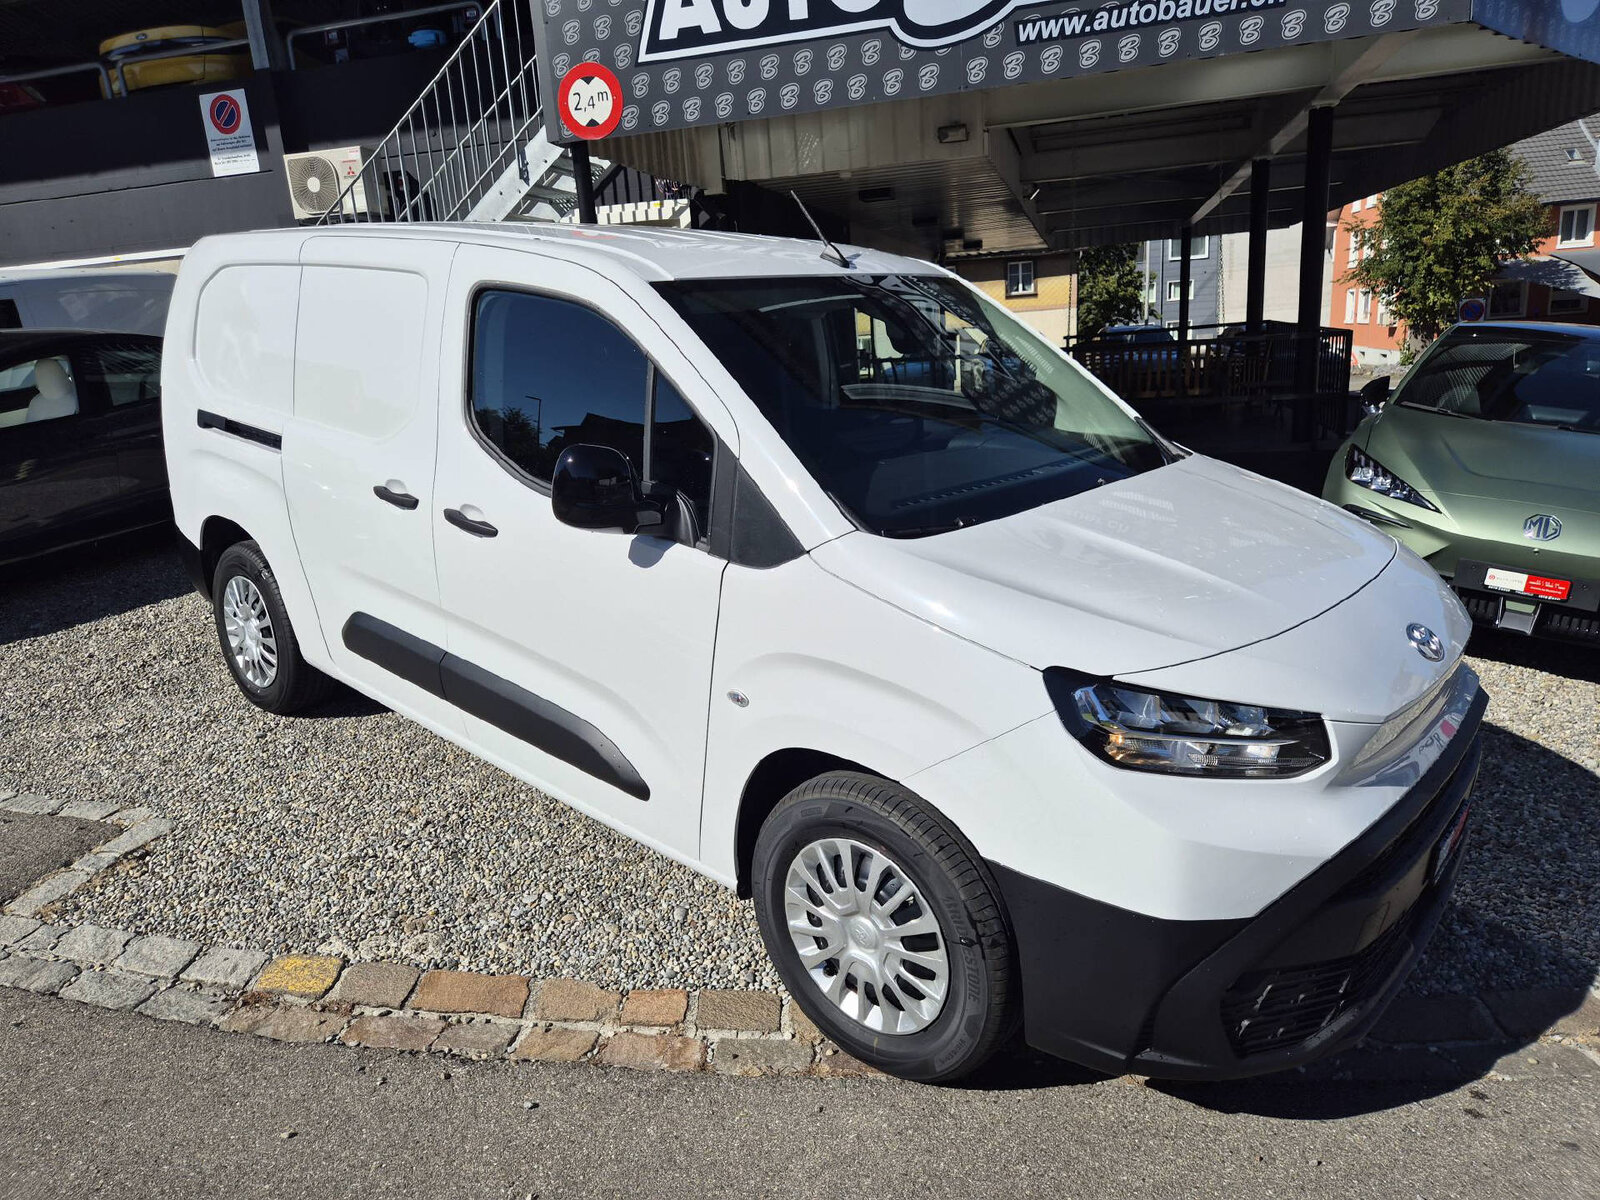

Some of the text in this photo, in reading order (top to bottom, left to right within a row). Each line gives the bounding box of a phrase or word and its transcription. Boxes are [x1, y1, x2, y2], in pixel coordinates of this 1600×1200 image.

[658, 0, 881, 41] AU
[1017, 0, 1285, 42] www.autobauer.
[1525, 515, 1561, 540] MG
[942, 896, 982, 1004] BRIDESTONE
